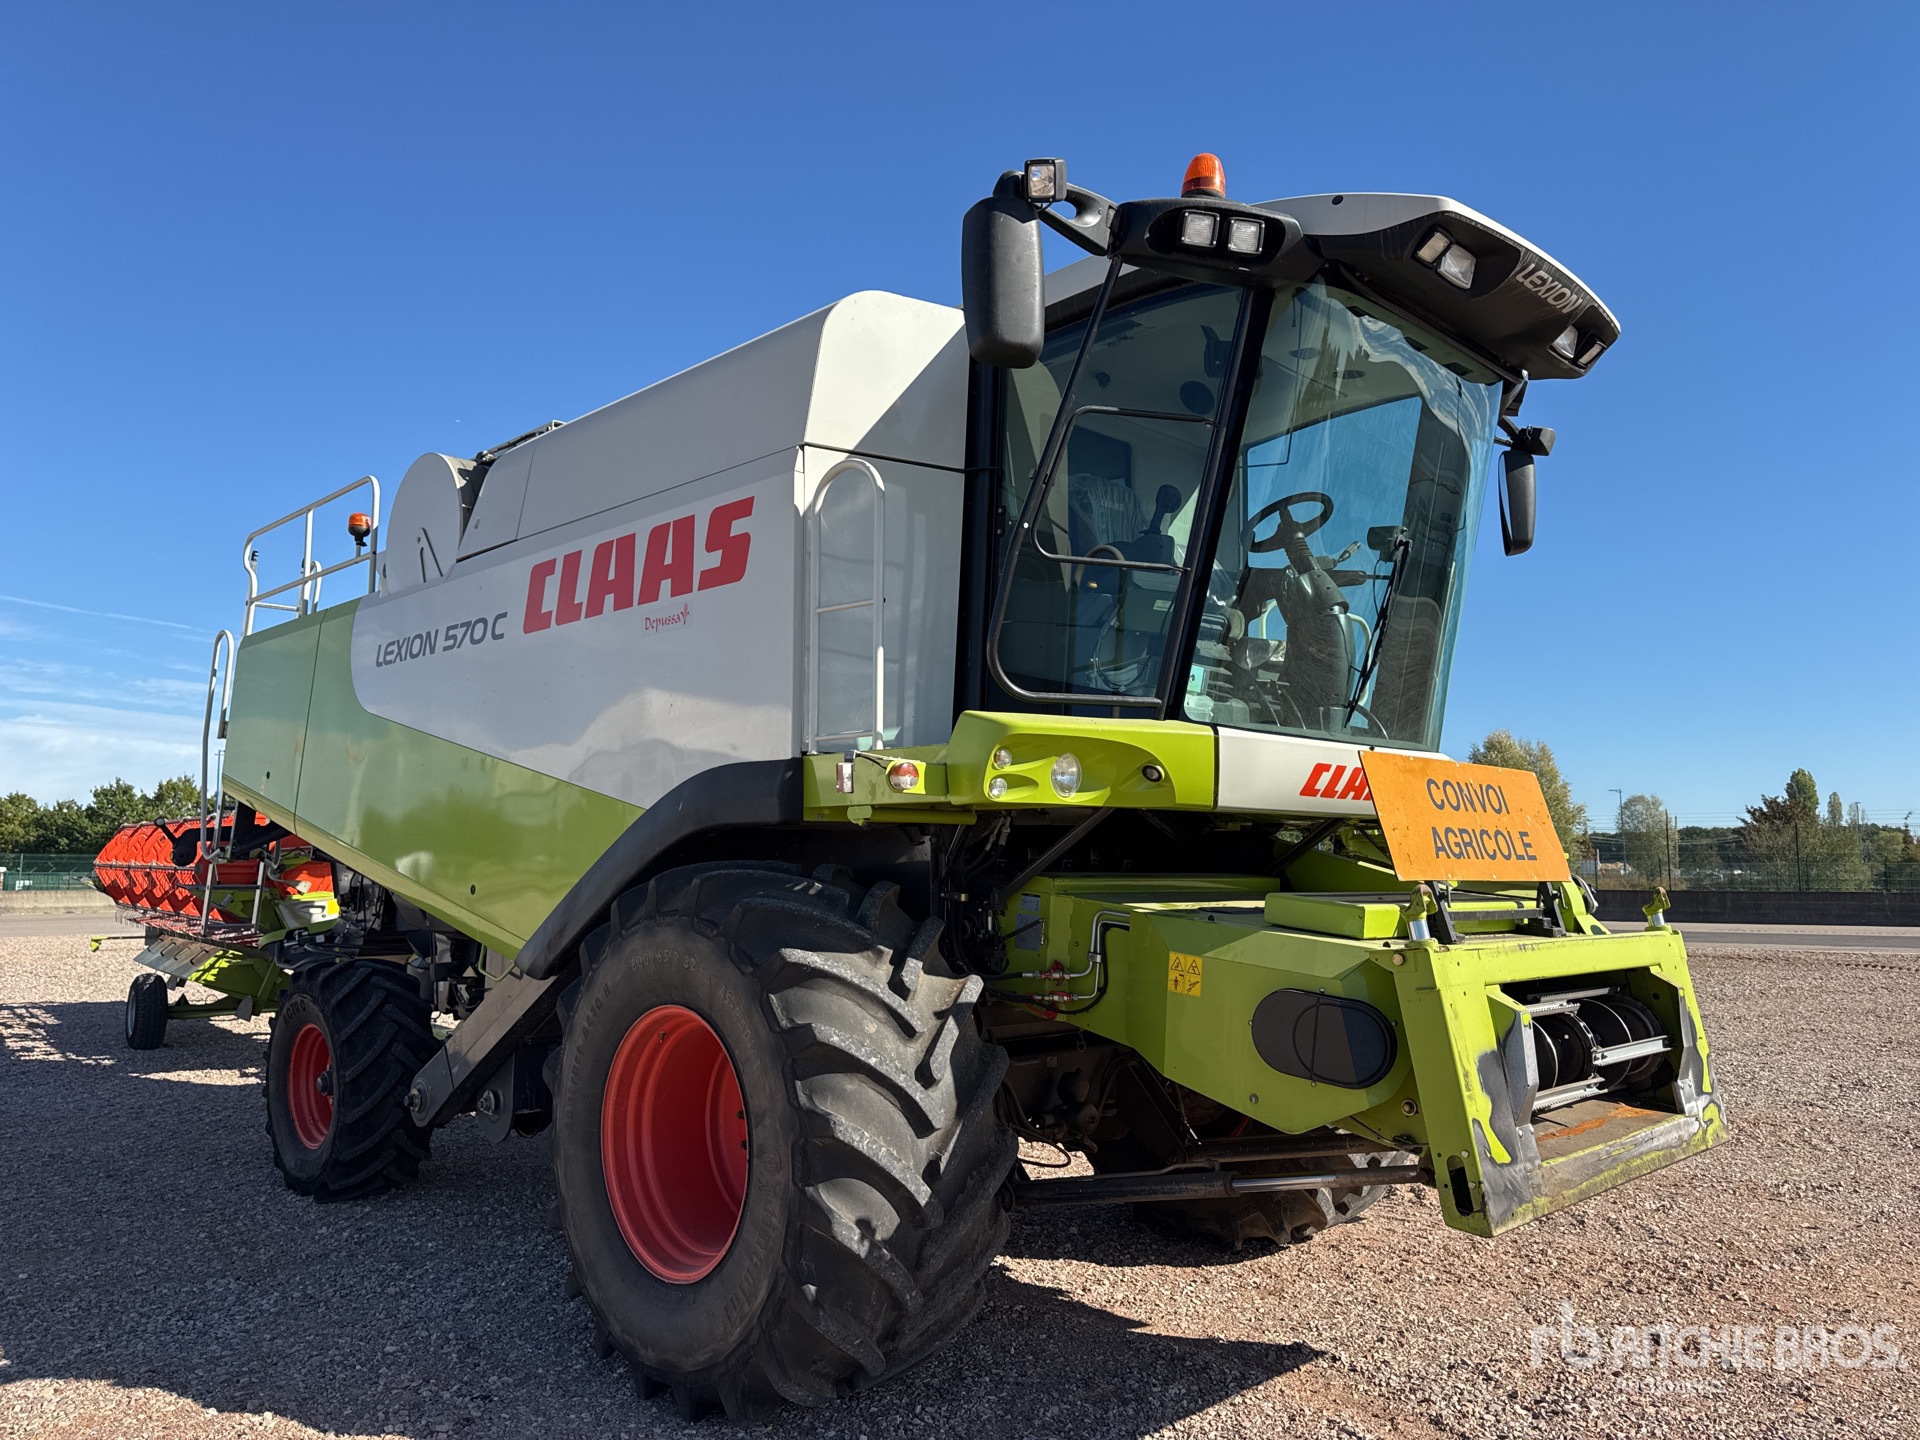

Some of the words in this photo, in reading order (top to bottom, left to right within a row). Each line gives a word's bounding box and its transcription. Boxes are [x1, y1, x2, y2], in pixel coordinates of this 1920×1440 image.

[1516, 263, 1583, 314] LEXION
[523, 495, 755, 635] CLAAS
[645, 604, 689, 632] Depussay
[375, 628, 439, 667] LEXION
[1299, 763, 1372, 801] CLA
[1426, 778, 1510, 815] CONVOI
[1432, 826, 1538, 861] AGRICOLE
